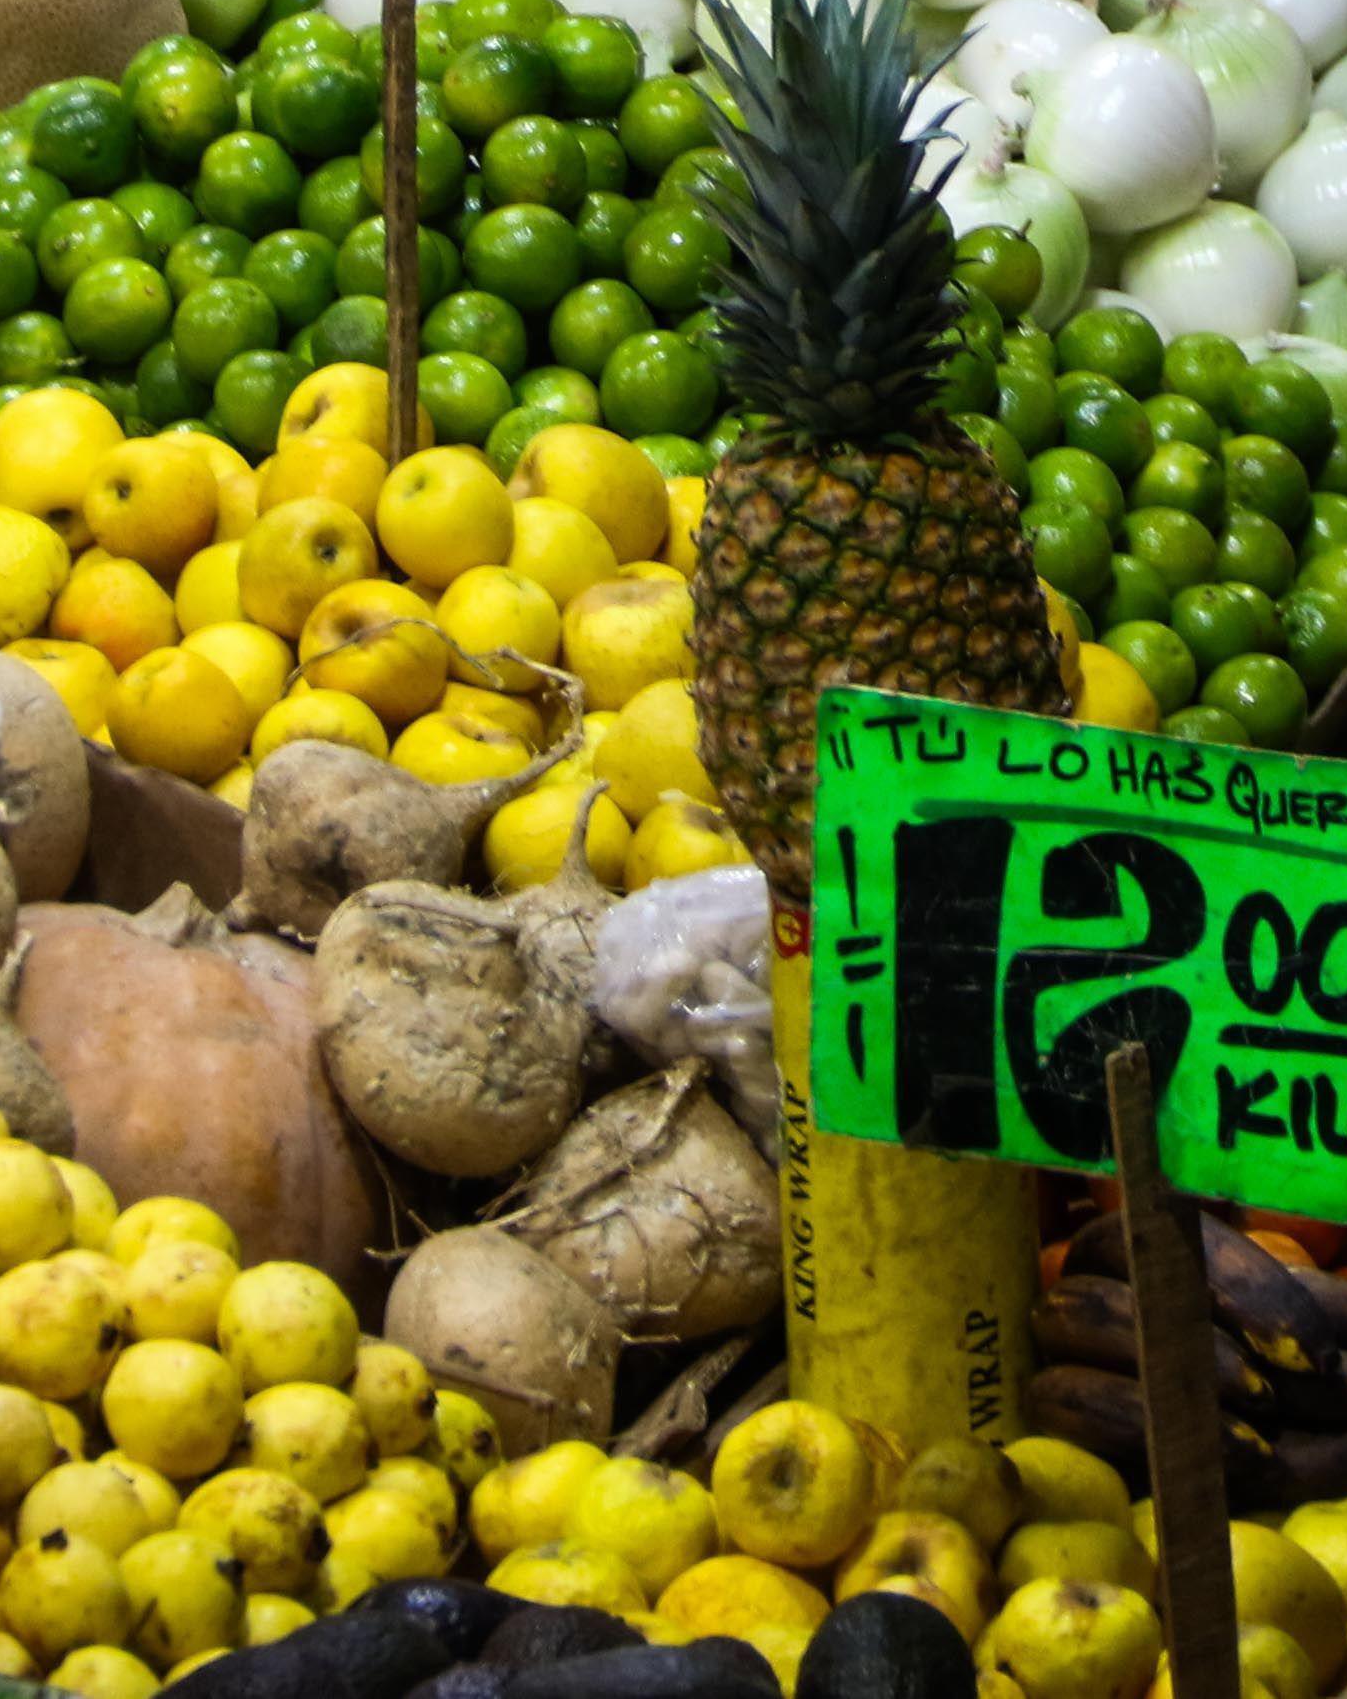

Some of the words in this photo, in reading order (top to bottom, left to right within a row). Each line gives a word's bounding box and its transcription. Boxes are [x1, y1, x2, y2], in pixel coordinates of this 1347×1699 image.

[998, 737, 1090, 780] LO
[1108, 742, 1215, 803] HAS
[893, 814, 1207, 1163] 12
[785, 1078, 811, 1200] WRAP
[790, 1213, 816, 1322] KING
[965, 1310, 1002, 1432] WRAP
